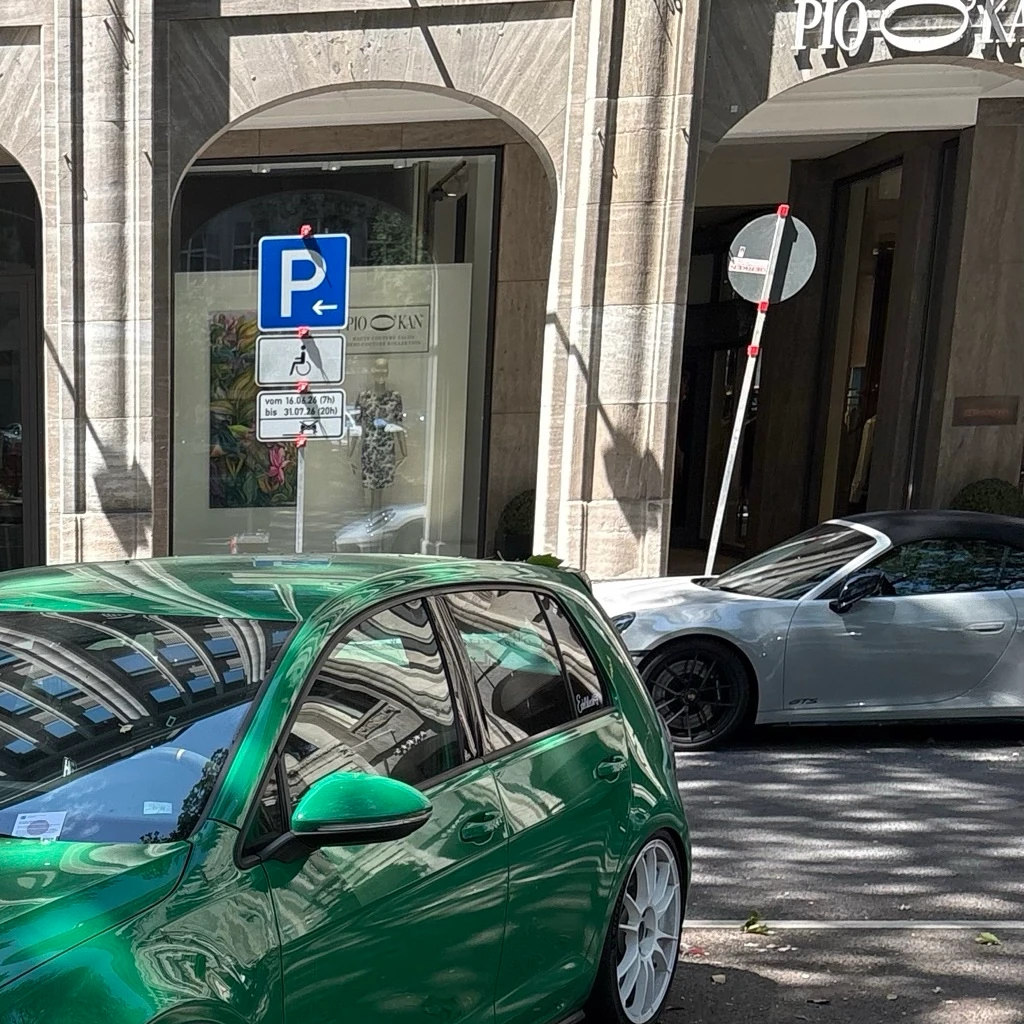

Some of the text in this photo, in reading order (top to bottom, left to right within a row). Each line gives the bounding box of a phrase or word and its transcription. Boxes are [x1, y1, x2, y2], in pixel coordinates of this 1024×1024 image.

[791, 0, 868, 51] PIO
[280, 249, 327, 317] P
[347, 316, 367, 331] PIO
[285, 396, 318, 405] 16.06.26
[319, 395, 336, 404] (7h)
[265, 407, 338, 416] bis 31.07.26 (20h)
